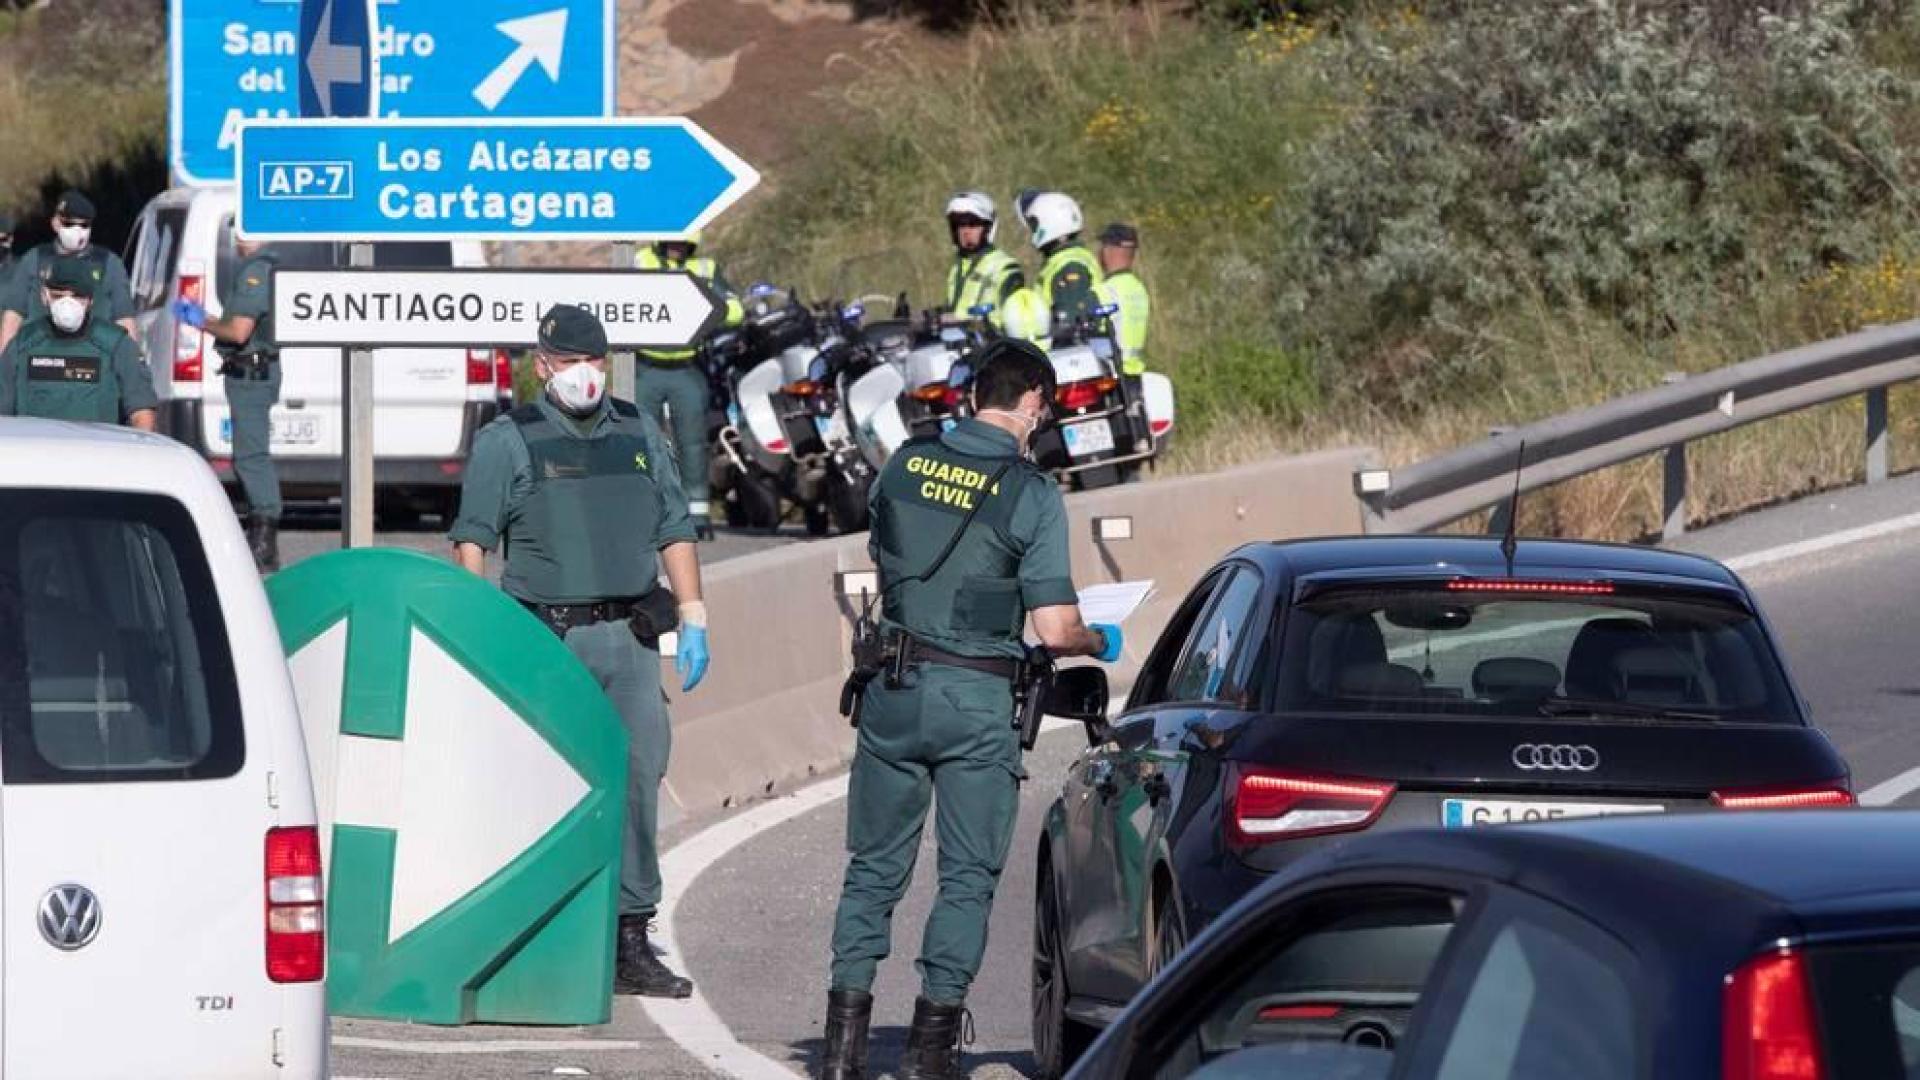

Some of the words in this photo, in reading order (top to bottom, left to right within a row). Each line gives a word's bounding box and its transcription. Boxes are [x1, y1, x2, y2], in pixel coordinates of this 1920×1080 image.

[223, 22, 296, 56] San
[376, 25, 435, 57] dro
[239, 66, 285, 92] del
[377, 141, 442, 172] Los
[468, 141, 652, 172] Alcázares
[268, 166, 346, 195] AP-7
[378, 183, 616, 227] Cartagena
[292, 292, 483, 322] SANTIAGO
[492, 302, 524, 322] DE
[920, 480, 973, 510] CIVIL
[195, 995, 234, 1011] TDI
